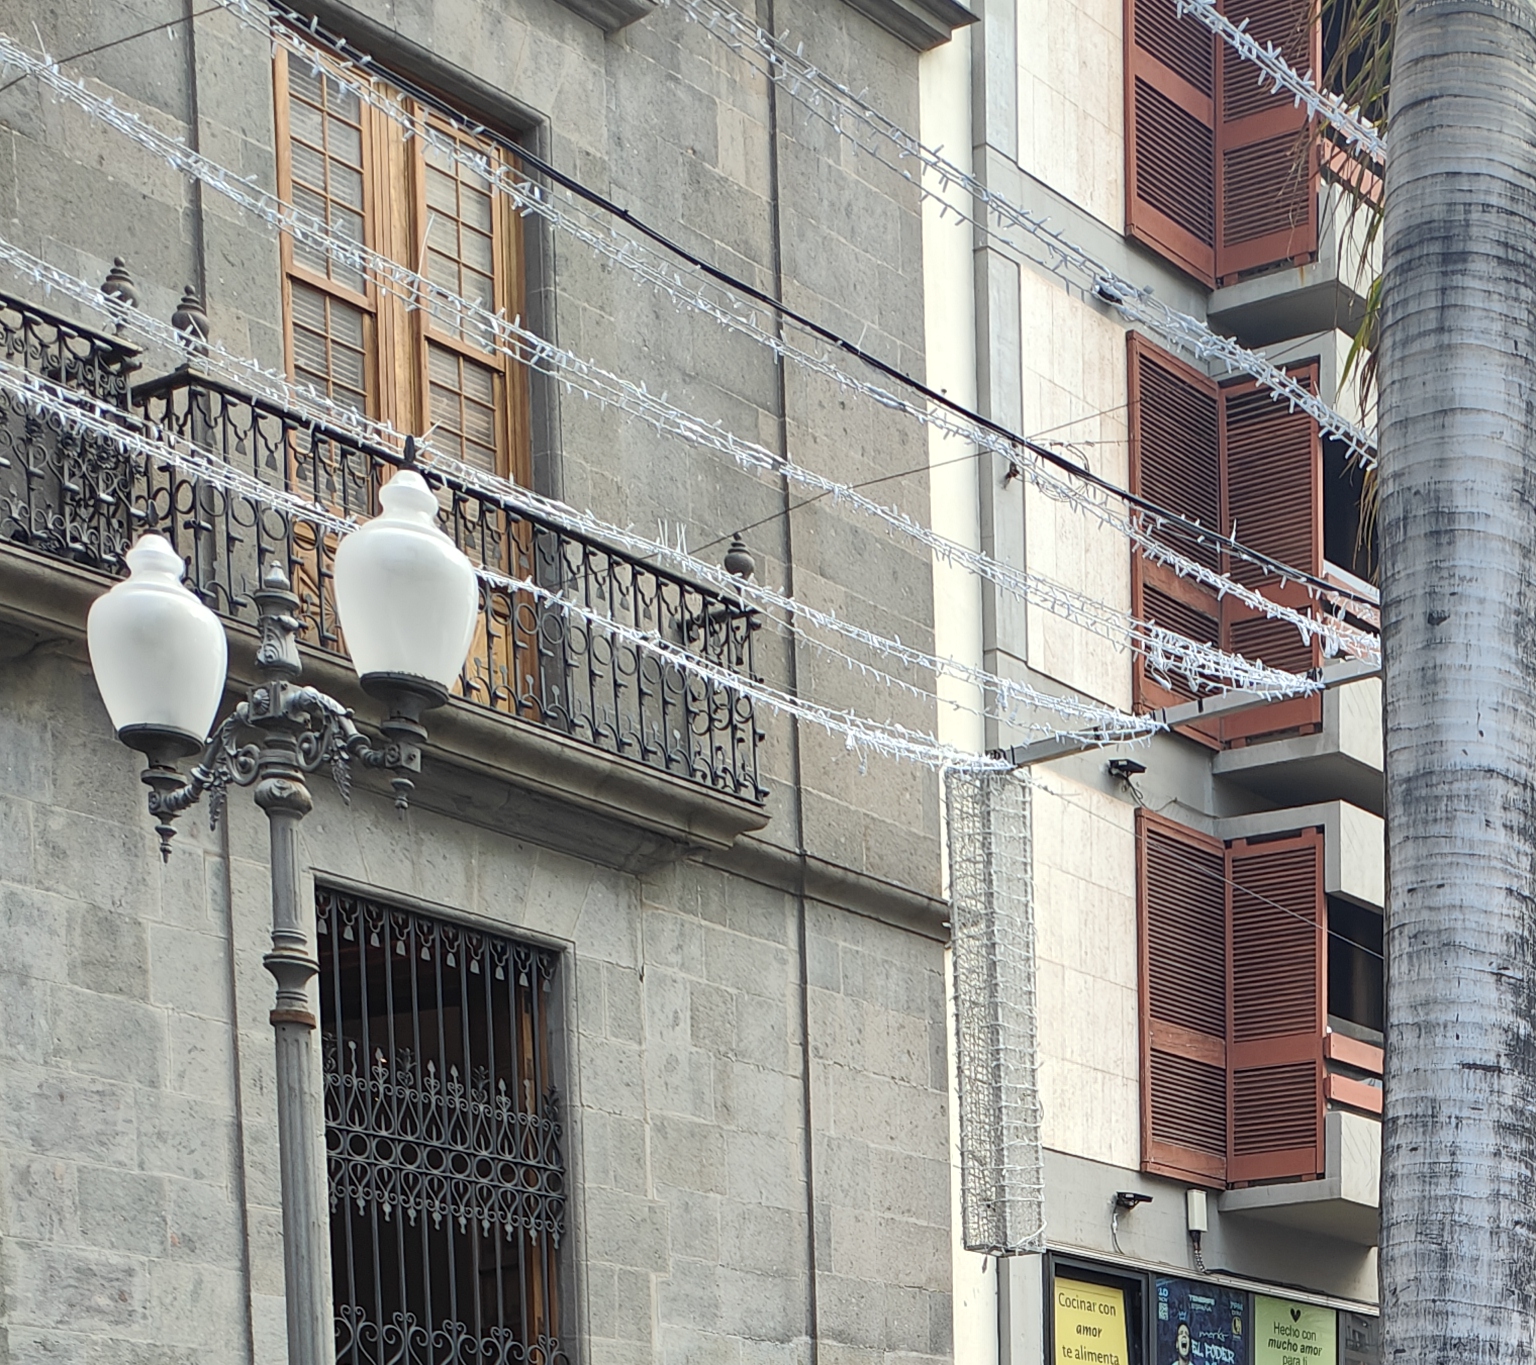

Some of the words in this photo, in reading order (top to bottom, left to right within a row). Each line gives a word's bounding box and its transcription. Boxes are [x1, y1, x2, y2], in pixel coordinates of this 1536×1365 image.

[1059, 1293, 1096, 1312] Cocinar
[1099, 1303, 1116, 1316] con
[1076, 1324, 1102, 1338] amor
[1273, 1322, 1299, 1338] Hecho
[1302, 1330, 1316, 1341] con
[1062, 1345, 1072, 1359] te
[1075, 1346, 1120, 1365] alimenta
[1192, 1339, 1204, 1357] EL
[1268, 1338, 1298, 1352] mucho
[1300, 1343, 1322, 1356] amor
